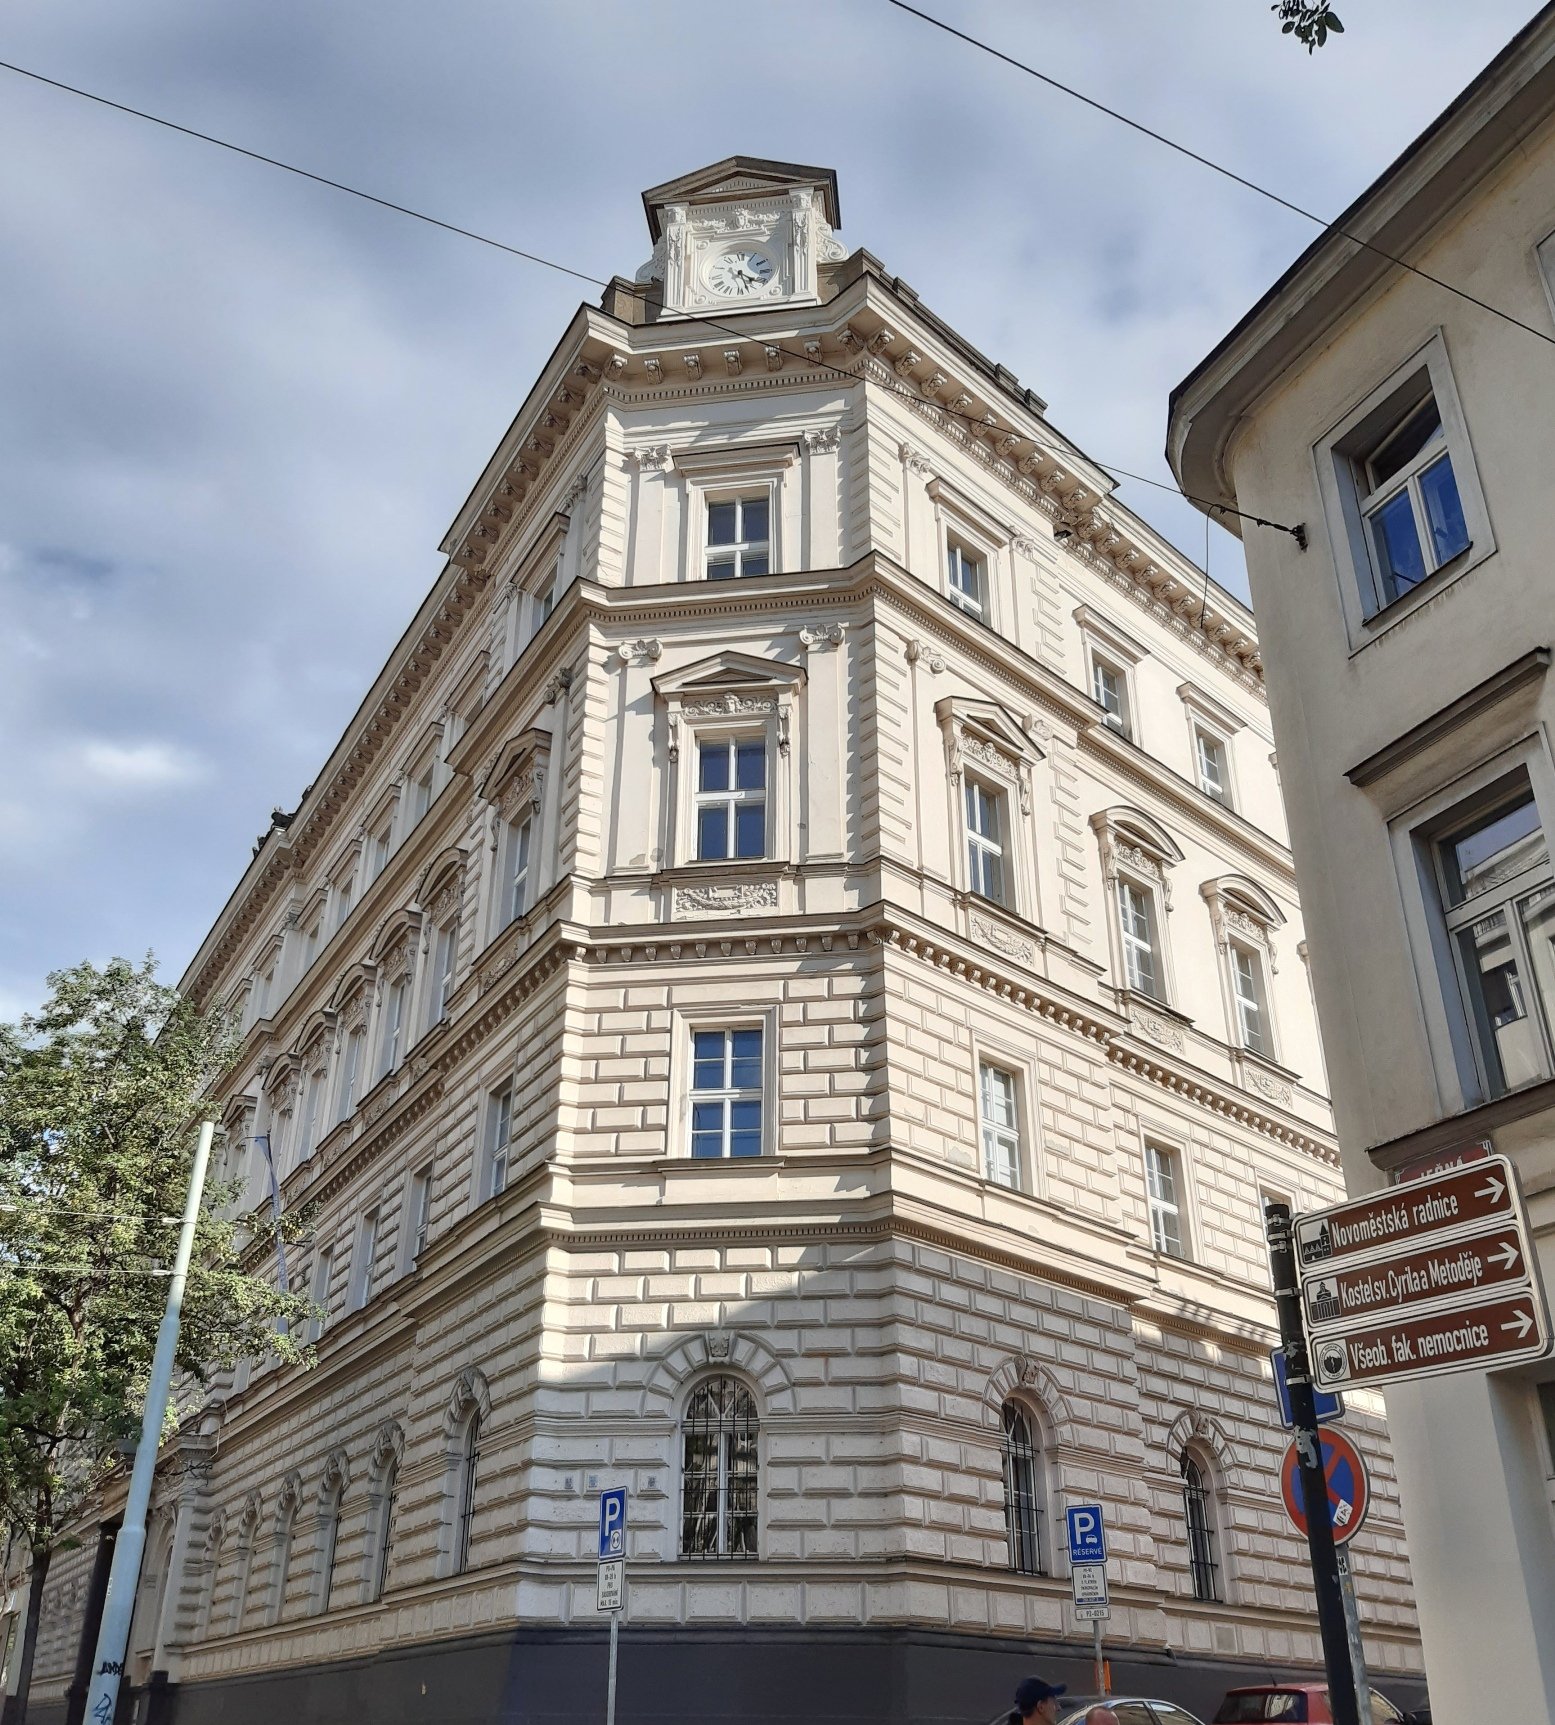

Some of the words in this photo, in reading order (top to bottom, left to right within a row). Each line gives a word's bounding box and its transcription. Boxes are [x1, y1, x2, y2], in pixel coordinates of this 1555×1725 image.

[1332, 1203, 1409, 1248] Novoměstská
[1413, 1192, 1459, 1226] radnice
[1340, 1275, 1375, 1309] Kostel
[1374, 1282, 1389, 1301] sv.
[1388, 1267, 1420, 1303] Cyrila
[1420, 1270, 1429, 1290] a
[1428, 1251, 1483, 1288] Metoděje
[1350, 1338, 1391, 1370] Všeob.
[1392, 1333, 1417, 1362] fak.
[1417, 1320, 1489, 1358] nemocnice
[605, 1497, 620, 1537] P
[1074, 1512, 1095, 1545] P
